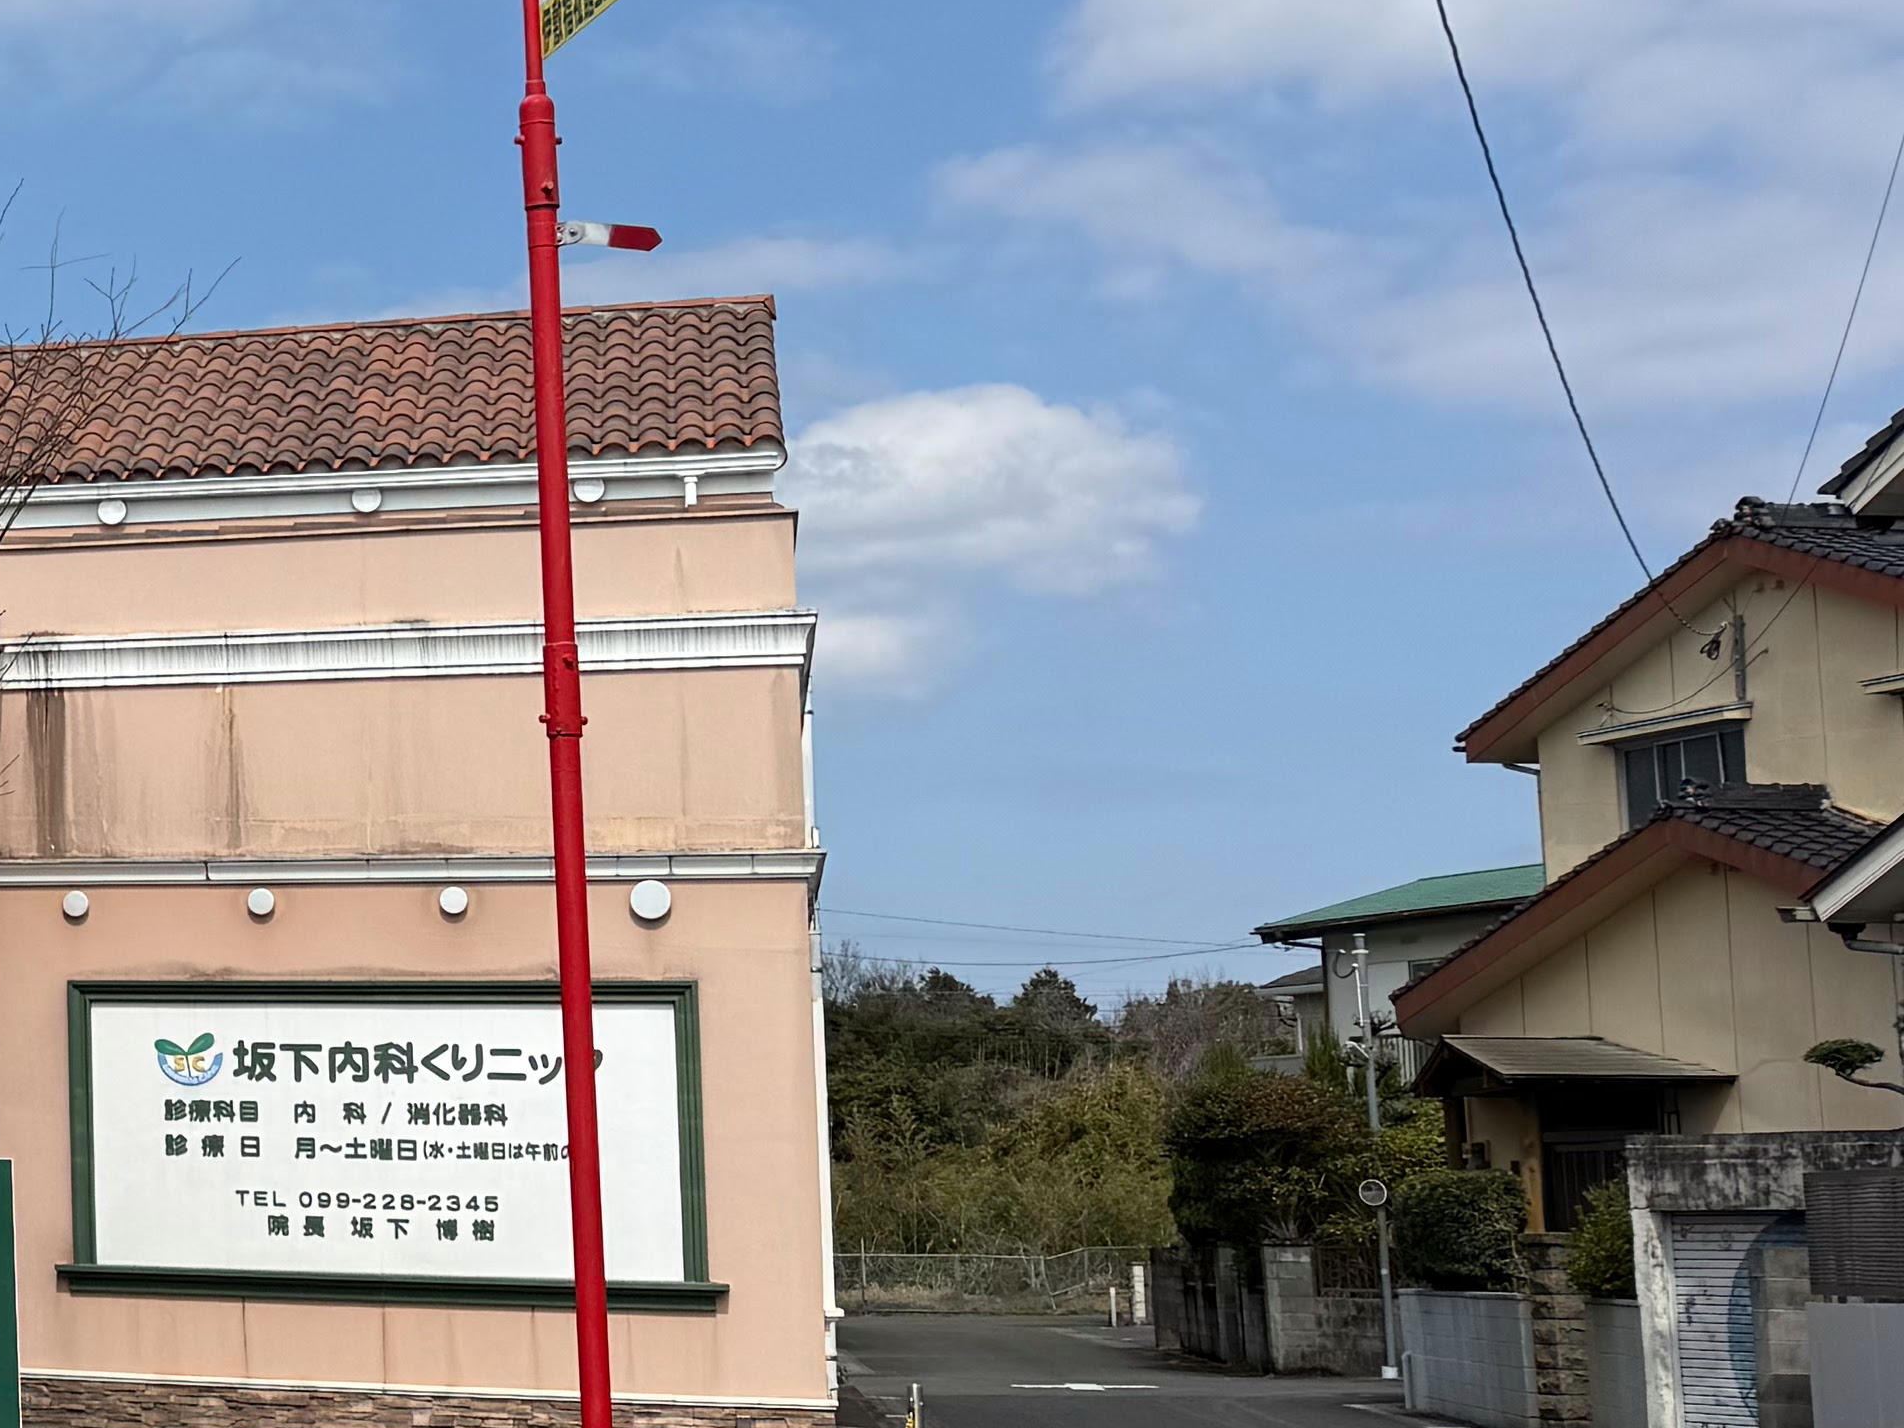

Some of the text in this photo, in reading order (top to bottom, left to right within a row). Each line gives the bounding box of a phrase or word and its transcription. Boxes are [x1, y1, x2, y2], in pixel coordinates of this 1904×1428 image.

[232, 1039, 603, 1085] 坂下内科くりニッ
[235, 1190, 499, 1213] TEL 099-228-2345
